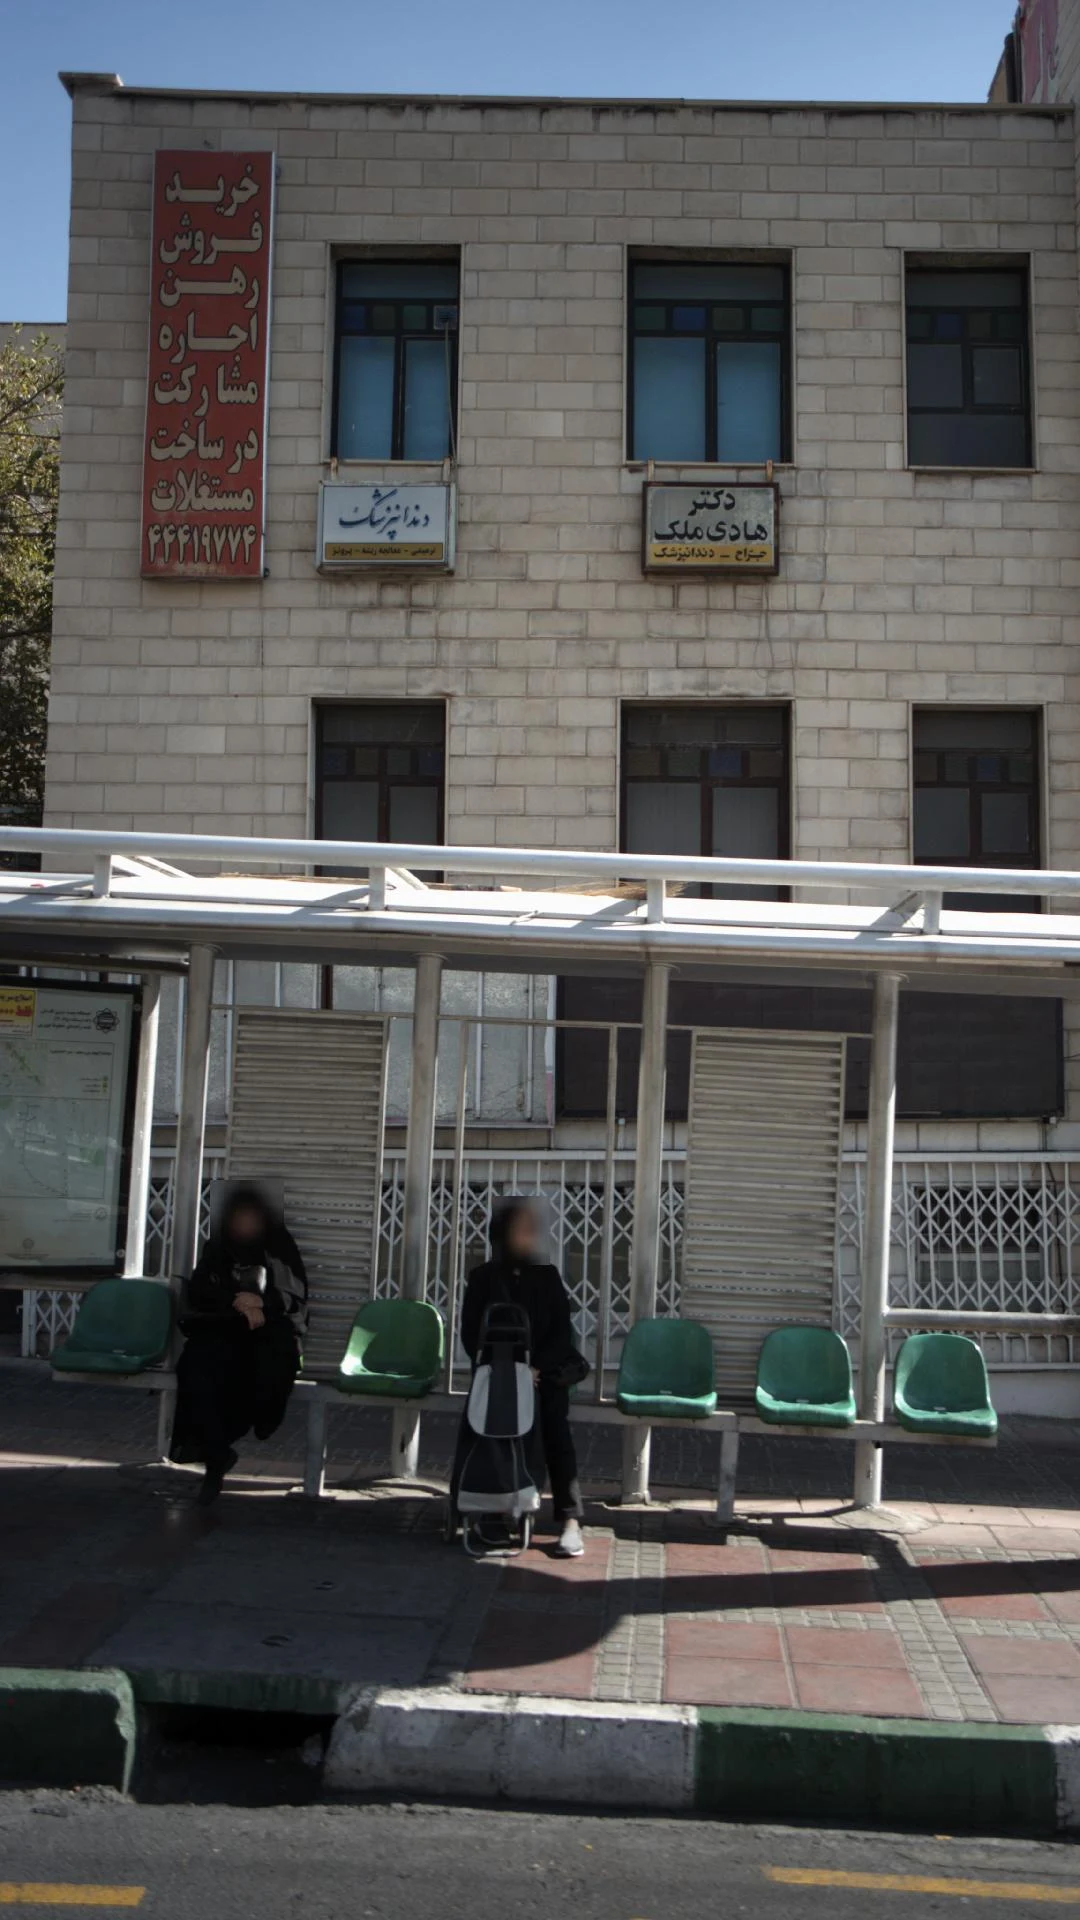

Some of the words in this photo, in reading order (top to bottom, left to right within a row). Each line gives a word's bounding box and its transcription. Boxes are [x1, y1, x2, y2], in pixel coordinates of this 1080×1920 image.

[165, 163, 260, 217] خرید
[159, 209, 264, 265] فروش
[159, 265, 261, 309] رهن
[158, 311, 259, 364] اجاره
[153, 362, 259, 418] مشارکت
[150, 418, 225, 462] ساخت
[226, 428, 259, 475] در
[151, 467, 256, 513] مستغلات
[687, 489, 736, 516] دکتر
[338, 488, 431, 540] دندانپزشک
[654, 520, 704, 541] ملک
[706, 520, 769, 542] هادی
[147, 523, 257, 564] ۴۴۴۱۹۷۷۴
[653, 547, 715, 561] دندانپزشک
